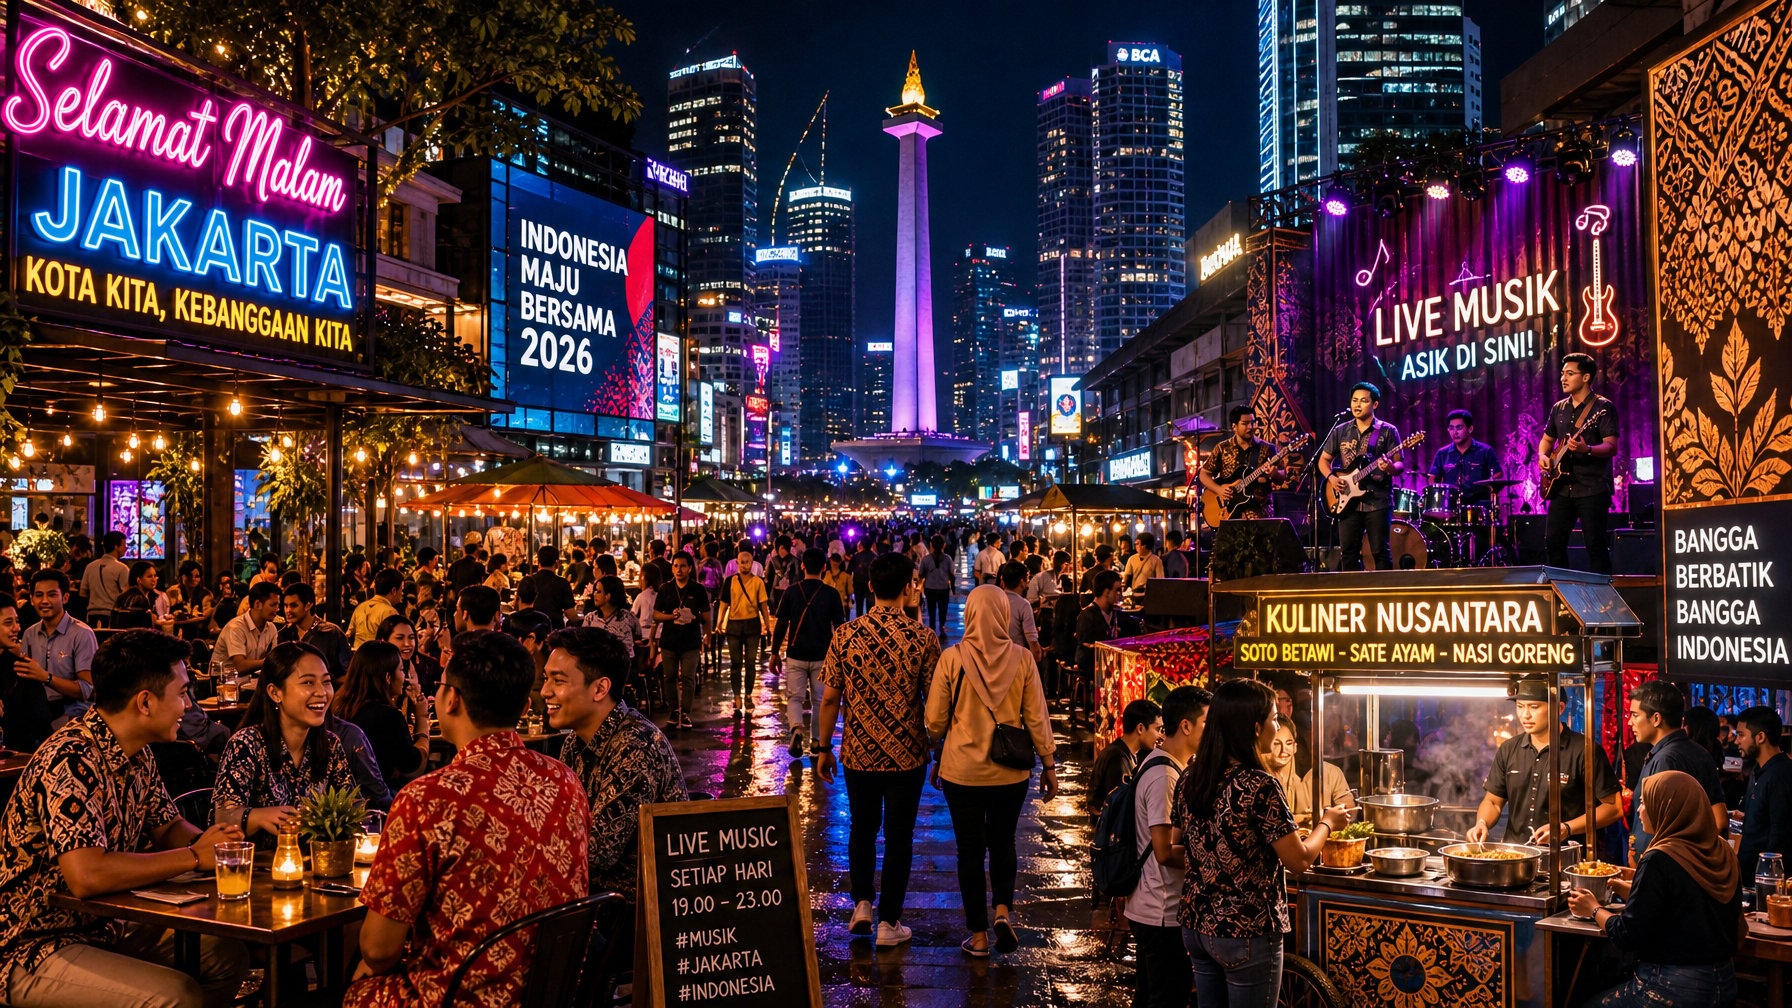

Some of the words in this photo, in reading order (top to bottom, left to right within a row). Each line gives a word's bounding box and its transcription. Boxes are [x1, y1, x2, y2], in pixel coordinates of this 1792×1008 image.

[1130, 47, 1161, 63] BCA
[4, 27, 216, 168] Selamat
[224, 103, 347, 213] Malam
[31, 166, 353, 309] JAKARTA
[520, 218, 628, 276] INDONESIA
[520, 254, 580, 296] MAJU
[26, 256, 97, 304] KOTA
[106, 273, 166, 322] KITA,
[175, 288, 309, 344] KEBANGGAAN
[315, 318, 353, 352] KITA
[520, 292, 616, 338] BERSAMA
[1375, 296, 1442, 347] LIVE
[1454, 270, 1560, 331] MUSIK
[520, 327, 593, 375] 2026
[1401, 344, 1449, 381] ASIK
[1456, 340, 1476, 371] DI
[1484, 330, 1534, 362] SINI!
[1675, 525, 1758, 554] BANGGA
[1676, 561, 1774, 589] BERBATIK
[1266, 602, 1367, 634] KULINER
[1377, 601, 1543, 633] NUSANTARA
[1676, 599, 1761, 625] BANGGA
[1240, 643, 1278, 662] SOTO
[1282, 643, 1335, 663] BETAWI
[1350, 643, 1386, 663] SATE
[1391, 643, 1435, 663] AYAM
[1453, 643, 1492, 663] NASI
[1499, 643, 1575, 665] GORENG
[1677, 634, 1790, 665] INDONESIA
[667, 831, 710, 856] LIVE
[719, 825, 778, 851] MUSIC
[670, 865, 727, 888] SETIAP
[735, 860, 773, 881] HARI
[672, 895, 715, 917] 19.00
[736, 889, 782, 910] 23.00
[676, 927, 738, 949] #MUSIK
[677, 949, 763, 975] #JAKARTA
[678, 975, 775, 1002] #INDONESIA
